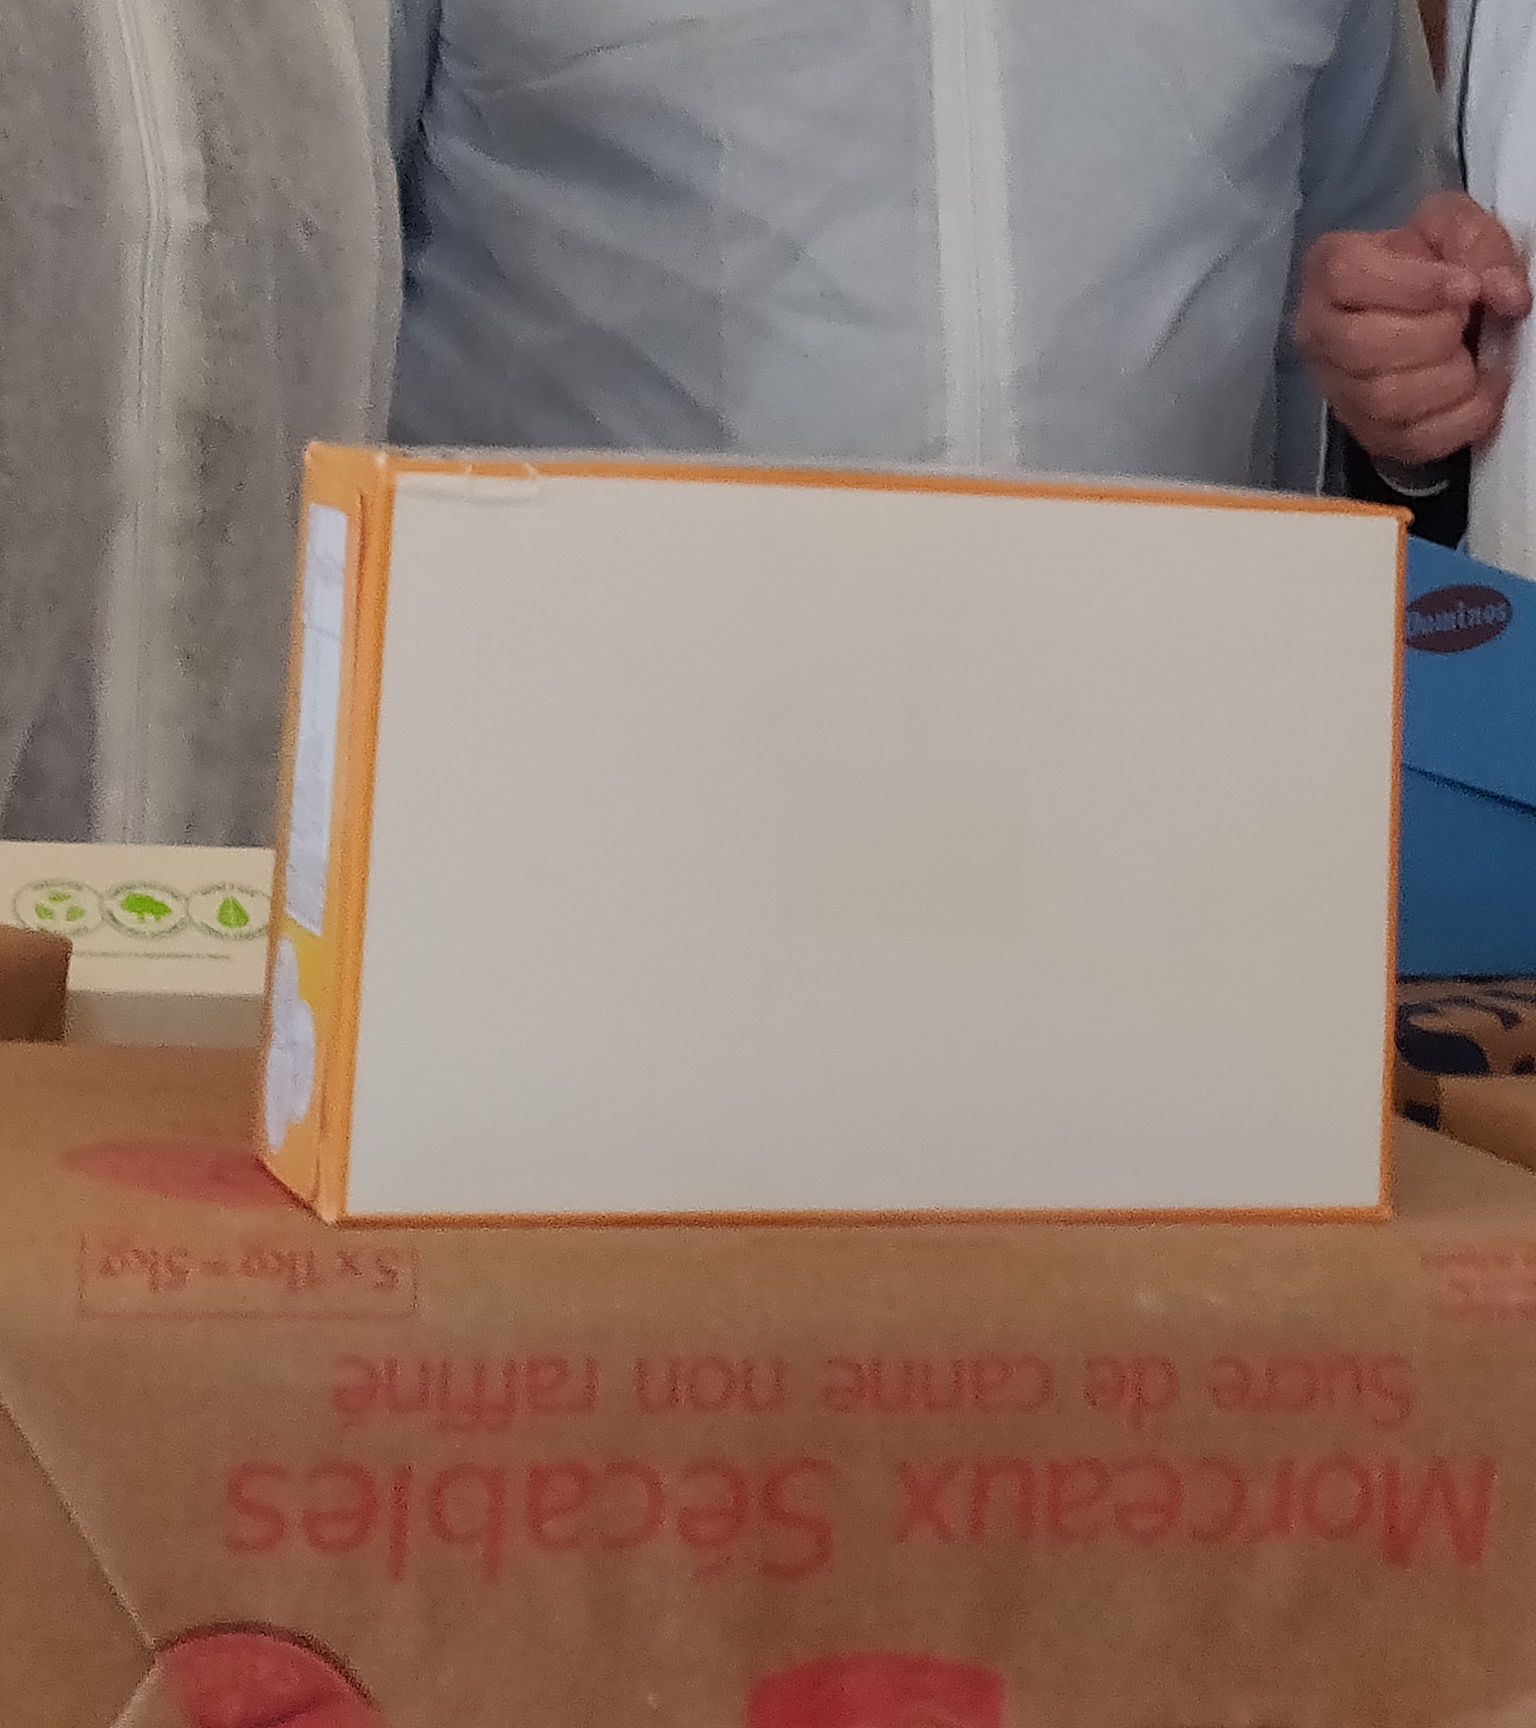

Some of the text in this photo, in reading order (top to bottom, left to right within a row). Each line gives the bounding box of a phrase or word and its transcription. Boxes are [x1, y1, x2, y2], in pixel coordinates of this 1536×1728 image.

[374, 1248, 399, 1293] 5
[330, 1354, 1414, 1434] Sucre de canne non raffiné
[222, 1454, 1497, 1583] Morceaux Sécables
